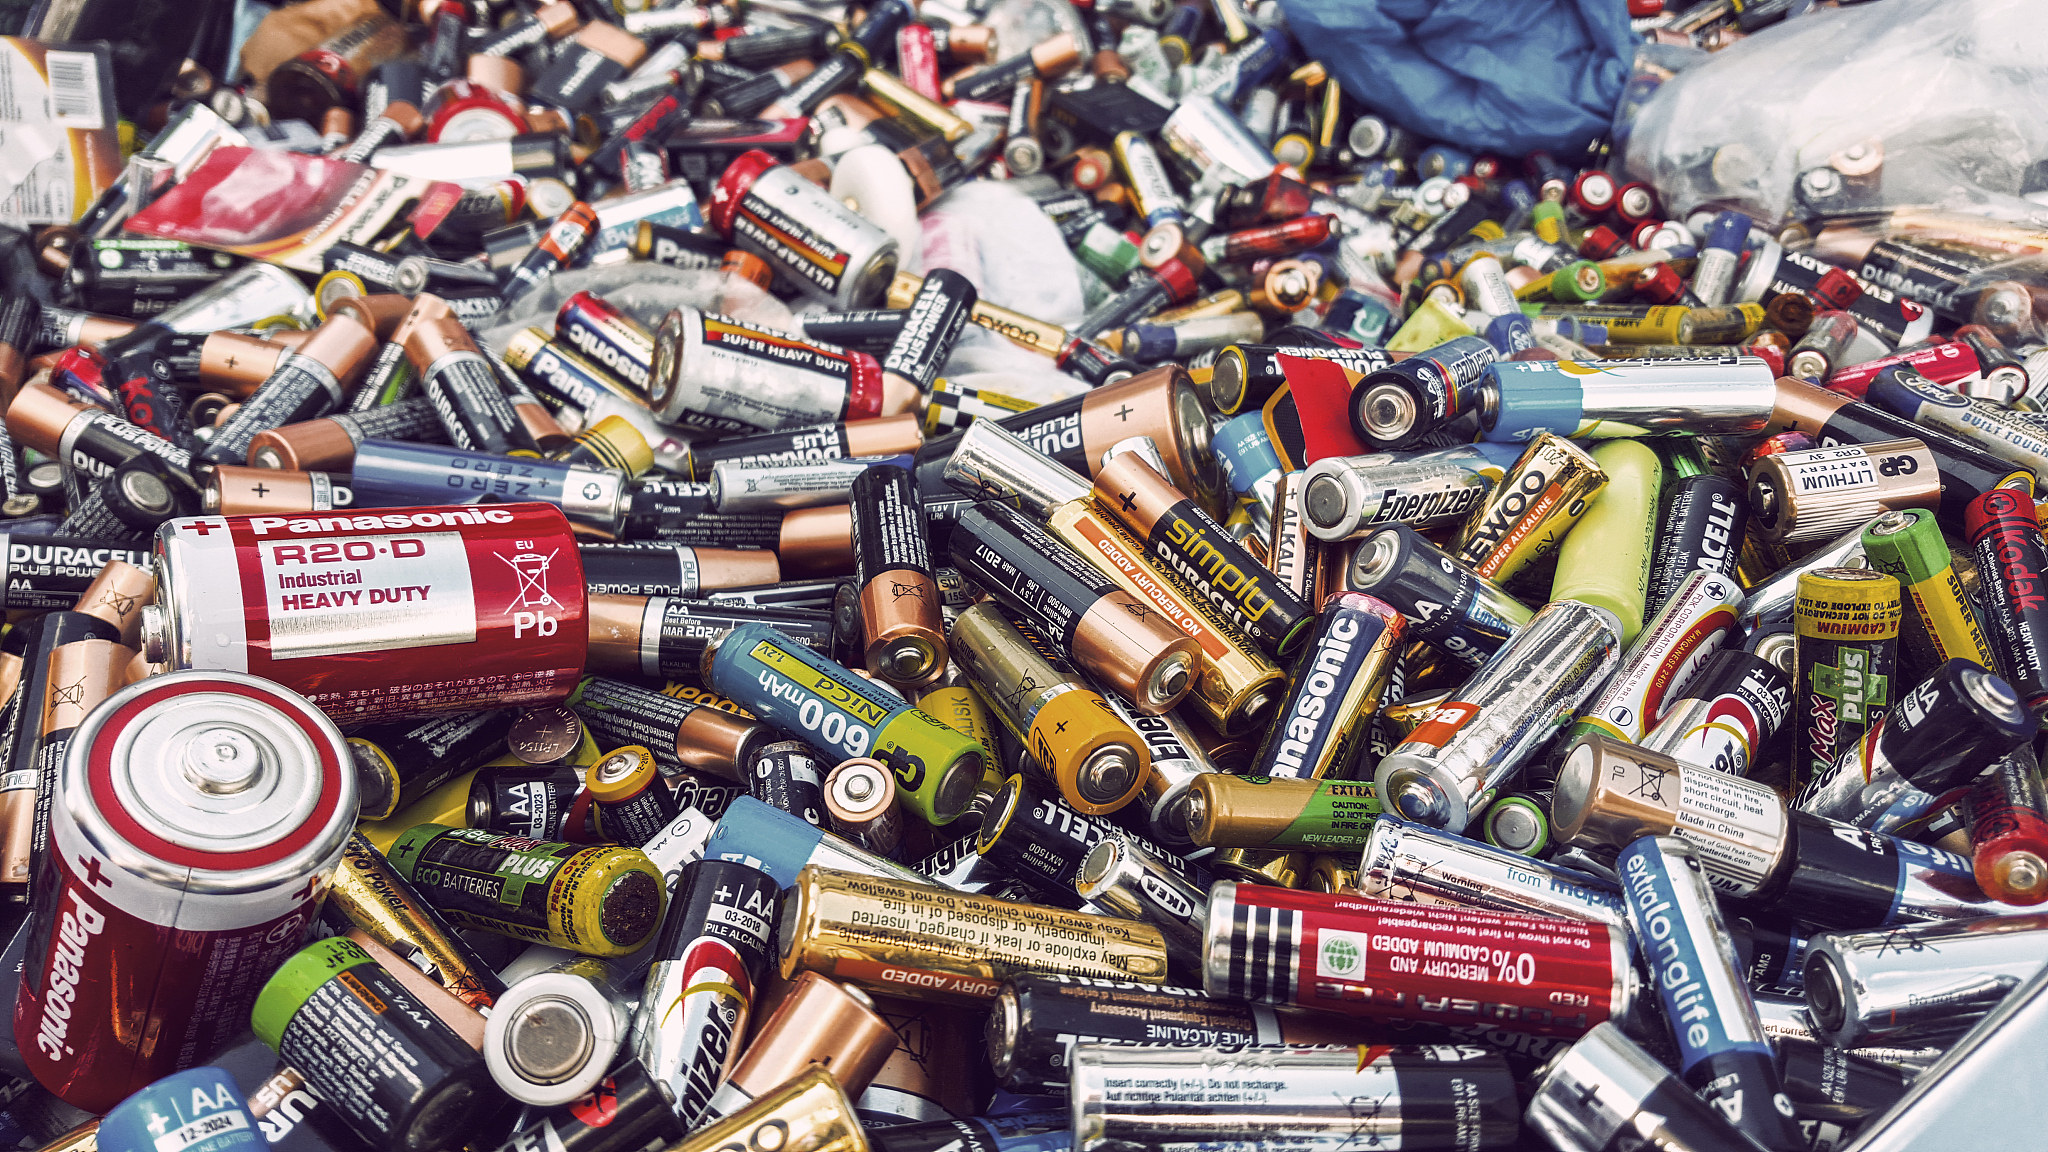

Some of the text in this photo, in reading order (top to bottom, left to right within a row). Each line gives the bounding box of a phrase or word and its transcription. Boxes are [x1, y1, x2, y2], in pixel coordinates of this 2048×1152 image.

[721, 332, 849, 372] SUPER HEAVY DUTY
[1906, 375, 1956, 401] Ford
[1961, 412, 2002, 436] BUILT
[1800, 459, 1869, 474] BATTERY
[1808, 448, 1862, 461] CR2 3V
[1878, 454, 1918, 477] GP
[1802, 470, 1874, 492] LITHIUM
[931, 512, 944, 520] LR6
[1369, 485, 1483, 525] Energizer
[248, 508, 514, 535] Panasonic
[515, 540, 534, 550] EU
[1482, 495, 1553, 578] SUPER ALKALINE
[1661, 488, 1694, 584] DISPOSE BATTERY
[976, 544, 1016, 576] 2017 MAR
[1657, 534, 1670, 564] CONNECT
[9, 564, 52, 576] PLUS
[278, 569, 363, 589] Industrial
[1165, 518, 1274, 622] simply
[1994, 530, 2045, 614] Kodak
[9, 579, 32, 590] AA
[587, 583, 680, 595] PLUS POWER
[1026, 579, 1040, 593] LR6
[1098, 539, 1202, 637] NO MERCURY ADDED
[281, 585, 432, 612] HEAVY DUTY
[666, 604, 690, 615] AA
[1047, 595, 1073, 619] MN1500
[1835, 602, 1864, 612] EXPLODE
[1947, 574, 1974, 627] SUPER
[513, 611, 558, 639] Pb
[664, 616, 701, 626] Best Before
[1042, 603, 1068, 627] Alkaline
[1649, 593, 1704, 660] FDK CORPORATION
[1847, 610, 1879, 621] DO NOT
[663, 626, 684, 637] MAR
[1816, 621, 1886, 635] CADMIUM
[757, 643, 786, 664] 1.2V
[956, 636, 977, 662] CAUTION
[1656, 628, 1702, 689] MANGANESE 2400
[2025, 648, 2041, 671] DUTY
[1638, 663, 1651, 681] MADE
[831, 670, 897, 713] Rechargeable
[1736, 687, 1757, 706] PILE
[1842, 651, 1864, 721] PLUS
[1917, 676, 1940, 713] AA
[813, 675, 884, 723] NiCd
[1756, 687, 1779, 718] 03-2019
[1772, 686, 1792, 721] AA
[1499, 712, 1539, 753] responsibly
[1808, 695, 1837, 765] Max
[548, 782, 557, 810] BATTERY
[1332, 785, 1372, 797] EXTRA
[1684, 776, 1720, 793] dispose
[508, 783, 529, 816] AA
[533, 793, 543, 828] 03-2023
[1332, 801, 1370, 811] CAUTION:
[1684, 787, 1764, 816] short circuit, heat
[1695, 800, 1738, 820] recharge.
[1333, 810, 1371, 820] DO NOT
[1339, 822, 1360, 830] FIRE
[1679, 812, 1744, 839] Made in China
[1301, 834, 1354, 844] NEW LEADER
[1682, 832, 1731, 852] Product Gold
[1022, 851, 1057, 875] Alkaline
[1028, 842, 1064, 866] MX1500
[499, 854, 555, 879] PLUS
[1506, 866, 1542, 888] from
[364, 873, 409, 911] Power
[416, 867, 500, 899] ECO BATTERIES
[842, 878, 906, 901] swallow.
[1441, 870, 1483, 893] Warning
[551, 879, 565, 912] FREE
[743, 890, 773, 924] AA
[1148, 878, 1187, 914] IKEA
[724, 909, 761, 933] 03-2018
[958, 897, 1020, 921] children.
[1021, 908, 1056, 926] from
[704, 922, 766, 956] PILE ALCALINE
[851, 909, 1130, 970] May explode or leak if charged, inserted
[928, 906, 1107, 950] improperly, disposed of
[1371, 934, 1490, 962] CADMIUM ADDED
[1626, 853, 1711, 1049] extralonglife
[35, 887, 107, 1063] Panasonic
[880, 968, 948, 990] ADDED
[1389, 955, 1490, 982] MERCURY AND
[1489, 949, 1537, 986] 0%
[373, 980, 394, 997] SIZE
[1549, 991, 1590, 1008] RED
[1090, 1001, 1147, 1022] Accessory
[376, 1029, 394, 1044] and
[1146, 1024, 1253, 1044] PILE ALCALINE
[1104, 1077, 1288, 1091] Insert correctly Do not recharge.
[190, 1082, 238, 1116] AA
[1105, 1092, 1240, 1102] Auf achten
[178, 1114, 234, 1144] 12-2024
